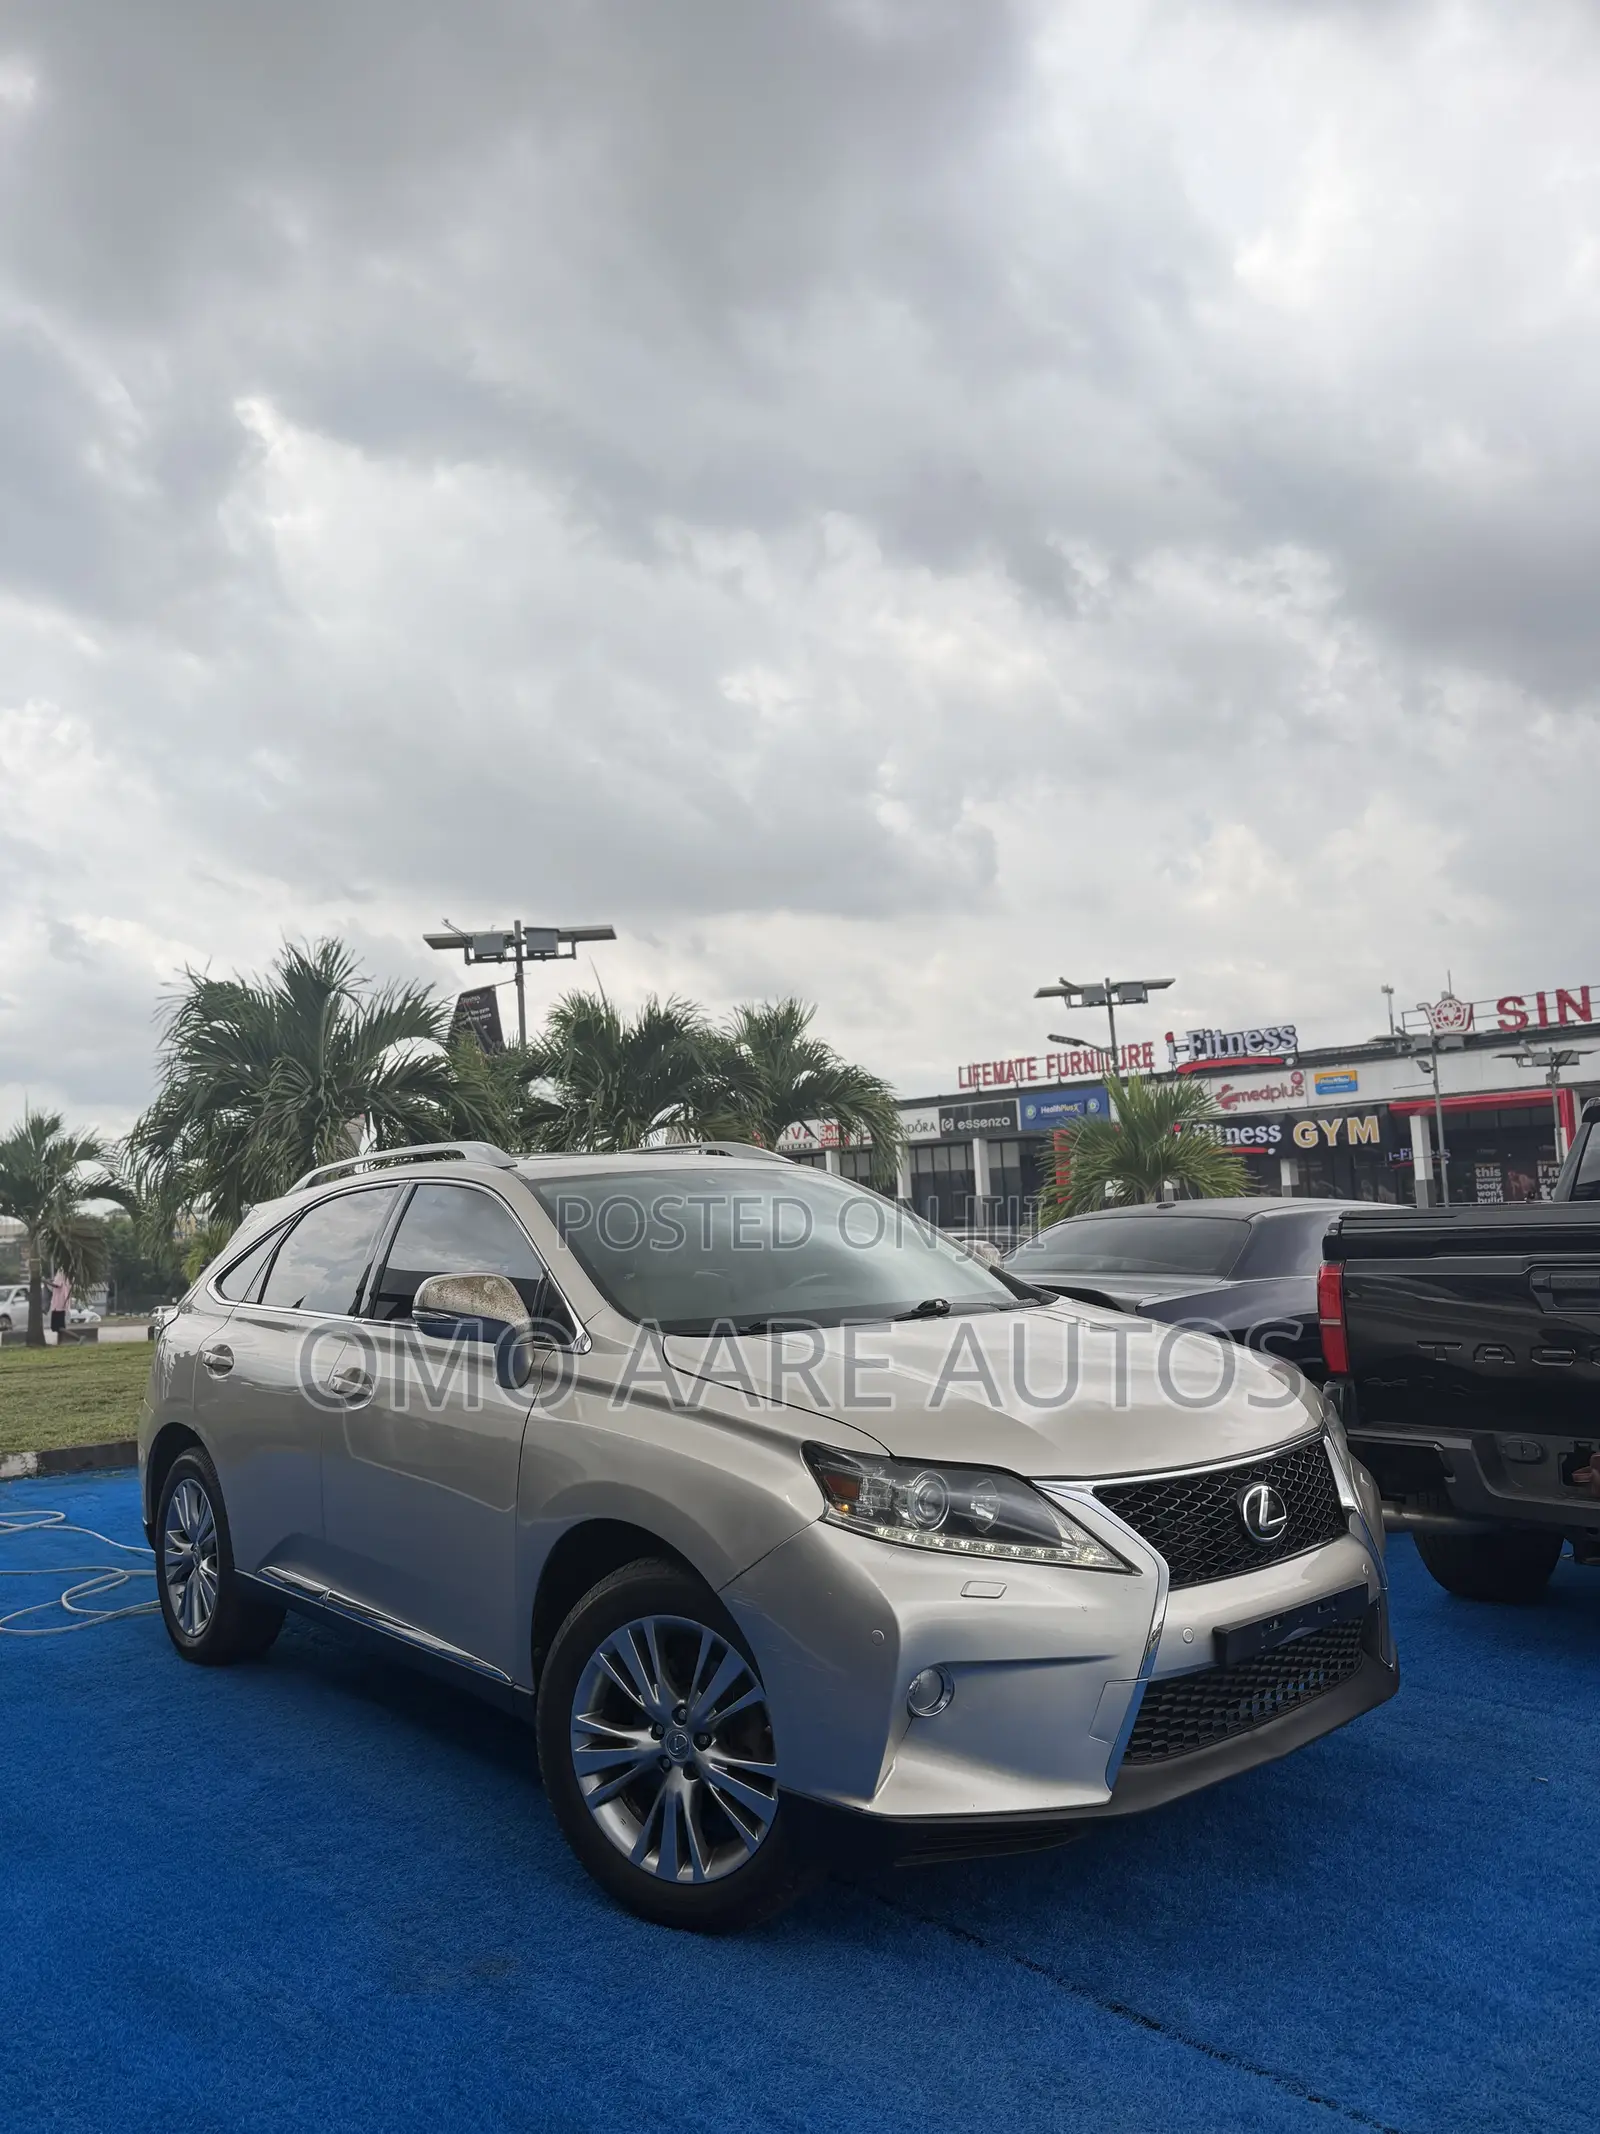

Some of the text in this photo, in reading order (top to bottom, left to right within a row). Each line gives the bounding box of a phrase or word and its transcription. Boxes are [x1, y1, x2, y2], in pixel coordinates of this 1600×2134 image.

[1496, 985, 1593, 1032] SIN
[1165, 1025, 1298, 1063] i-Fitness
[958, 1057, 1037, 1088] LIFEMATE
[1237, 1082, 1305, 1103] medplus
[957, 1115, 1011, 1130] essenza
[1292, 1115, 1380, 1149] GYM
[1475, 1167, 1502, 1177] this
[1476, 1183, 1502, 1191] body
